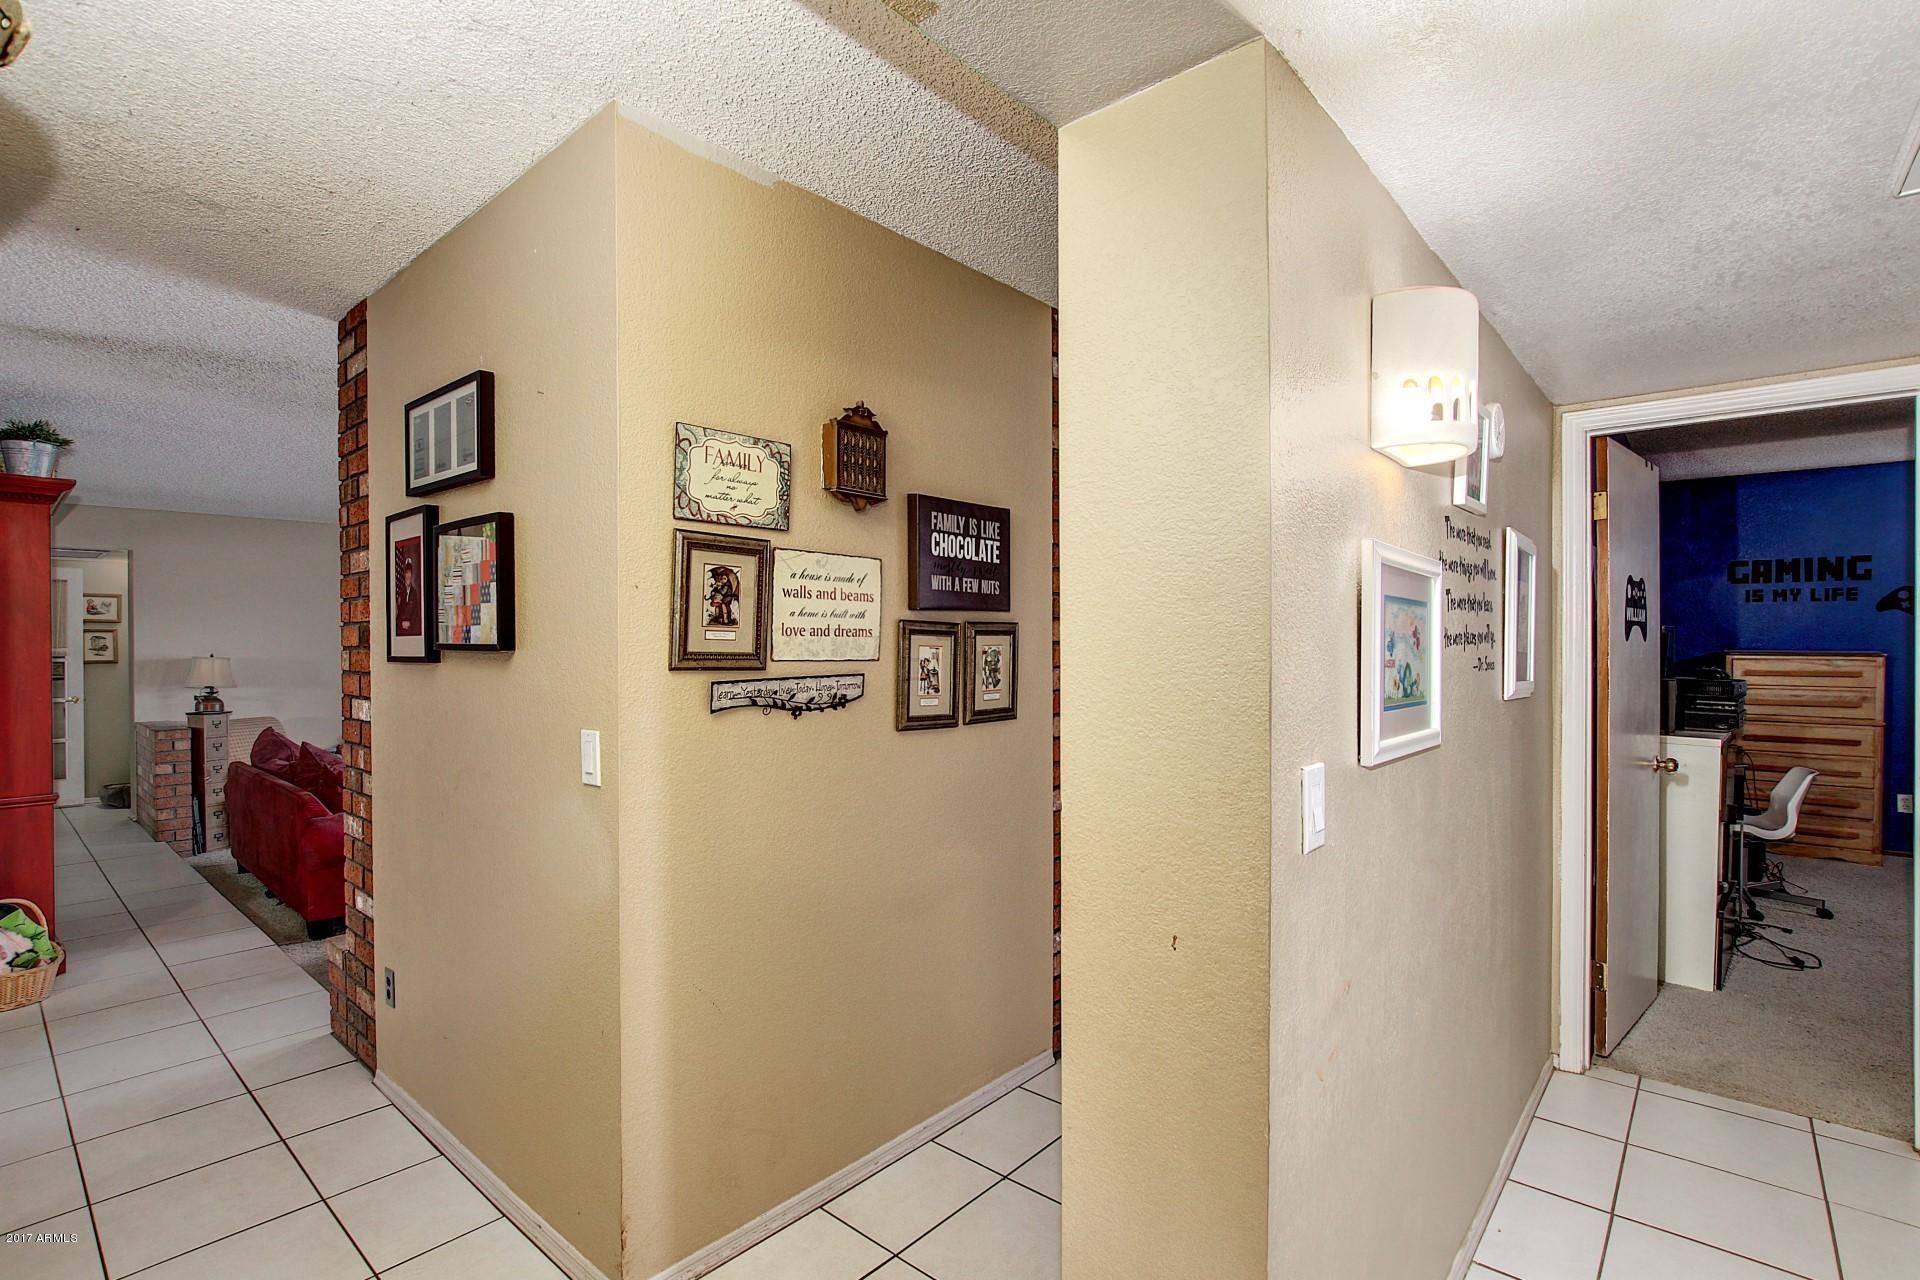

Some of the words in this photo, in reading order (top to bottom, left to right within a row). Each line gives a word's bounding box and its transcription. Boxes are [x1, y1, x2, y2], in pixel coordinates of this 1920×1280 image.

[704, 445, 766, 473] FAMILY
[704, 469, 726, 485] for
[727, 471, 759, 492] always
[704, 492, 736, 501] matter
[736, 492, 762, 505] what
[931, 511, 965, 534] FAMILY
[969, 517, 978, 536] IS
[980, 519, 1000, 540] LIKE
[931, 532, 1000, 564] CHOCOLATE
[789, 571, 797, 579] a
[798, 567, 823, 582] house
[824, 572, 831, 582] is
[832, 572, 855, 583] made
[856, 572, 868, 588] of
[1727, 554, 1873, 585] GAMING
[782, 584, 812, 599] walls
[815, 586, 837, 601] and
[840, 587, 874, 603] beams
[931, 574, 952, 591] WITH
[954, 576, 960, 592] A
[962, 577, 979, 593] FEW
[981, 579, 1000, 595] NUTS
[1744, 588, 1764, 603] IS
[1772, 588, 1802, 603] MY
[1810, 587, 1859, 602] LIFE
[789, 609, 796, 617] a
[797, 606, 819, 618] home
[821, 609, 828, 618] is
[829, 608, 849, 619] built
[849, 609, 868, 619] with
[1626, 607, 1646, 622] WILLIAM
[781, 622, 806, 637] love
[809, 623, 830, 637] and
[833, 623, 873, 638] dreams
[716, 687, 734, 701] Learn
